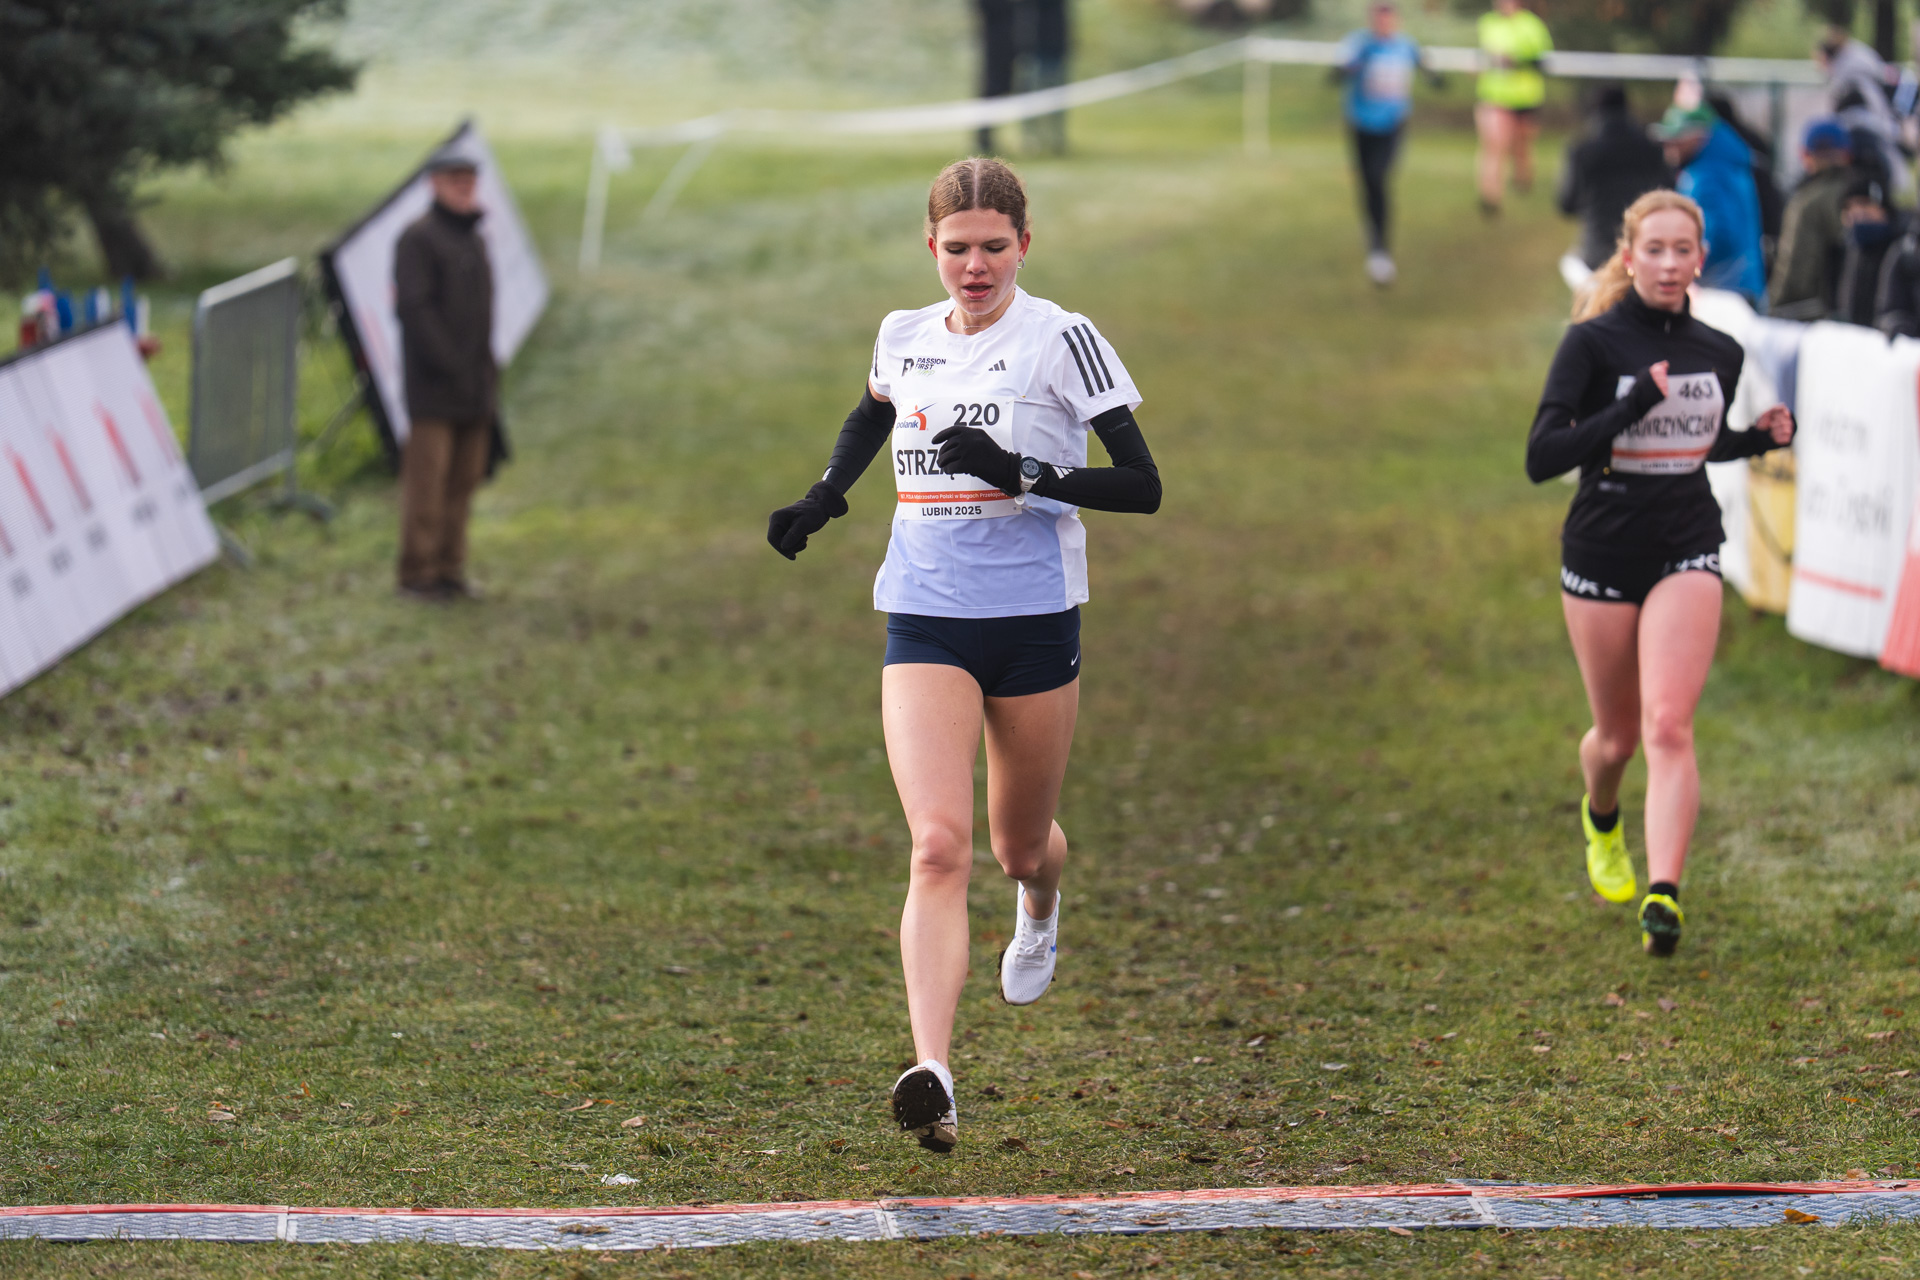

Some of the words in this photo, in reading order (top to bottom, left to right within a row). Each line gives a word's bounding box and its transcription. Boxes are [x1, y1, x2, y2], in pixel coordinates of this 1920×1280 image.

[1678, 381, 1714, 400] 463
[953, 402, 1000, 427] 220
[896, 419, 919, 431] polanik
[896, 448, 955, 481] STRZ
[959, 492, 979, 500] Biegach
[922, 507, 952, 516] LUBIN
[955, 505, 982, 515] 2025
